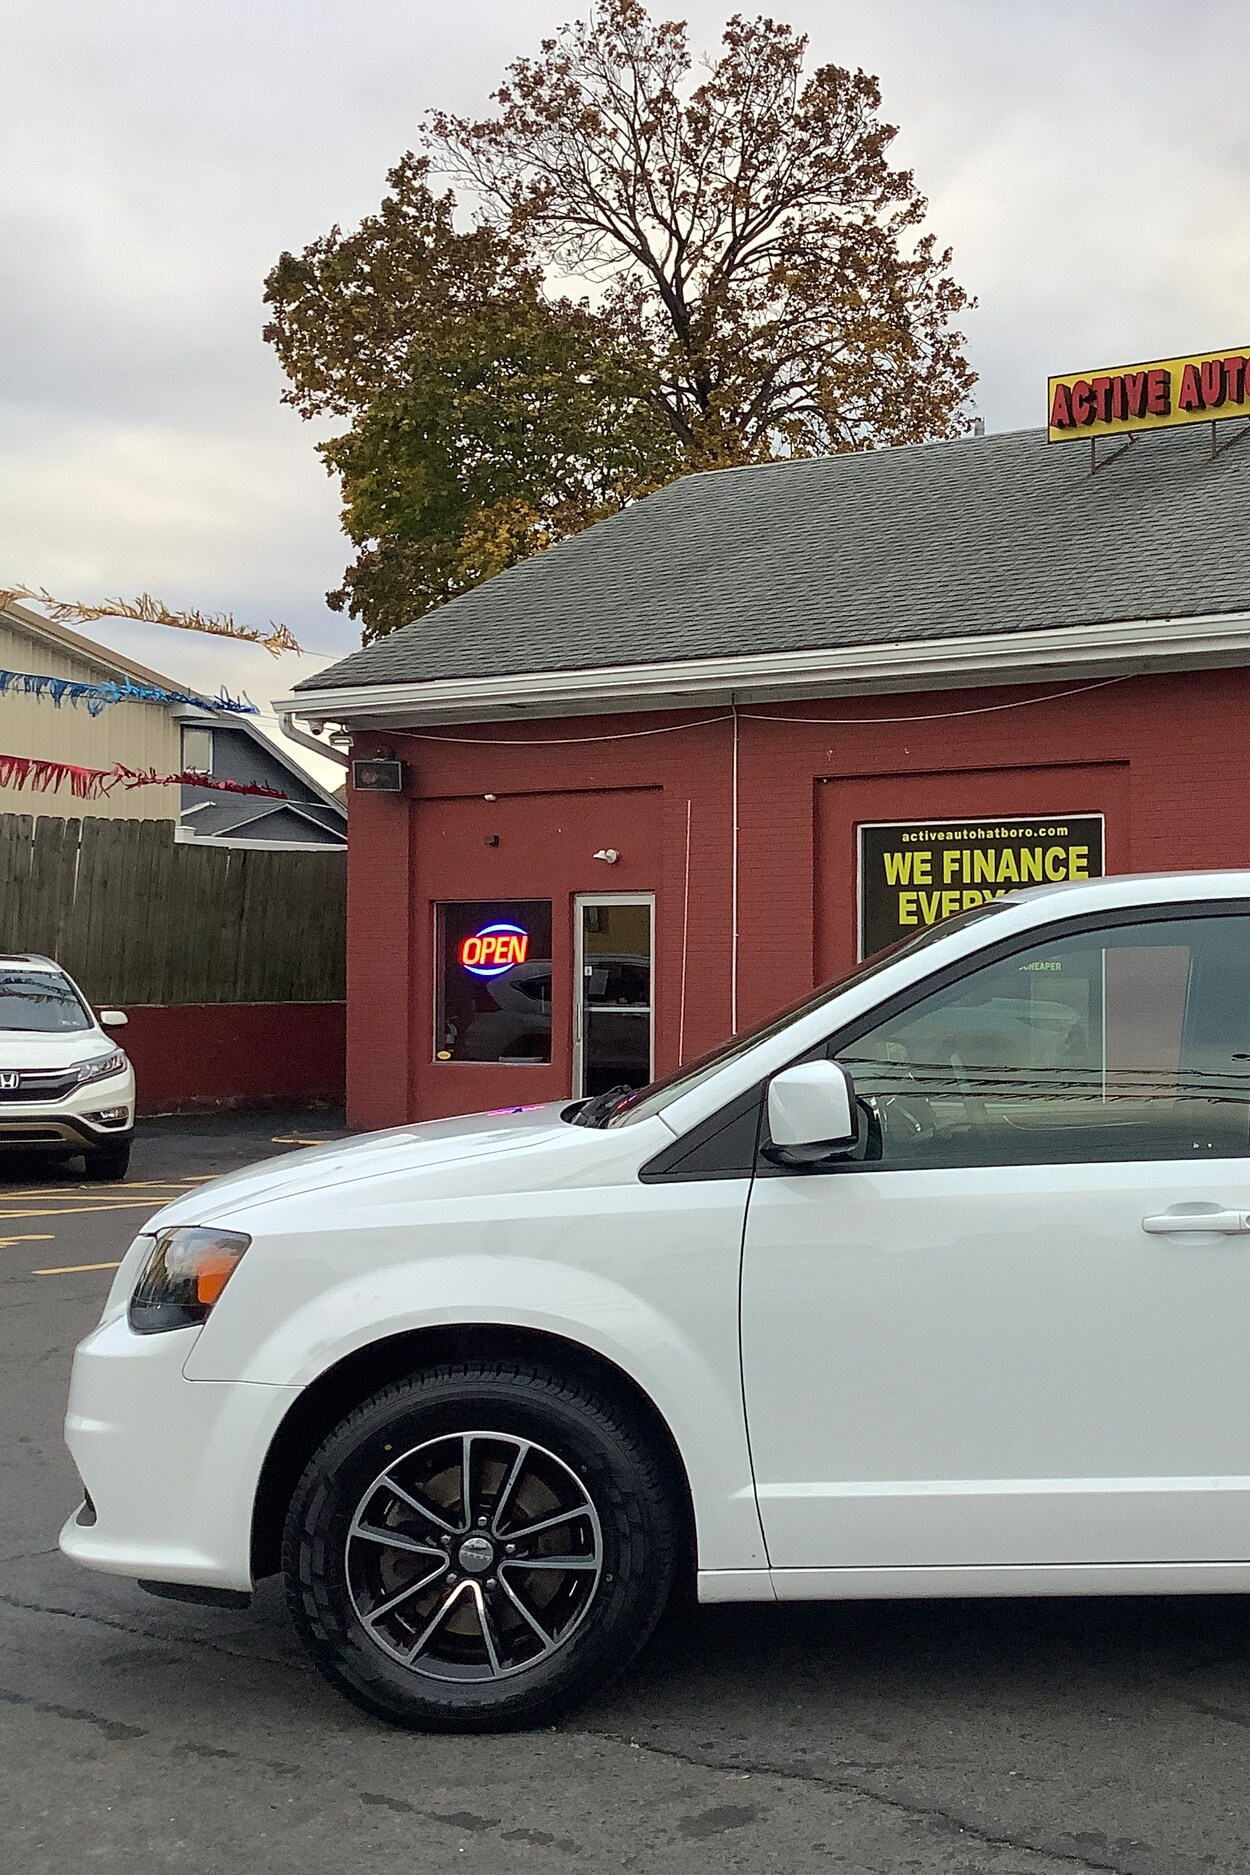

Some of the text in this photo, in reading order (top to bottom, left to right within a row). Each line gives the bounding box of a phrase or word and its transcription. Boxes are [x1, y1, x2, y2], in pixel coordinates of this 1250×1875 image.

[1051, 369, 1171, 429] ACTIVE
[901, 825, 1068, 842] activeautohatboro.com
[883, 846, 1089, 886] WE FINANCE
[462, 935, 528, 964] OPEN
